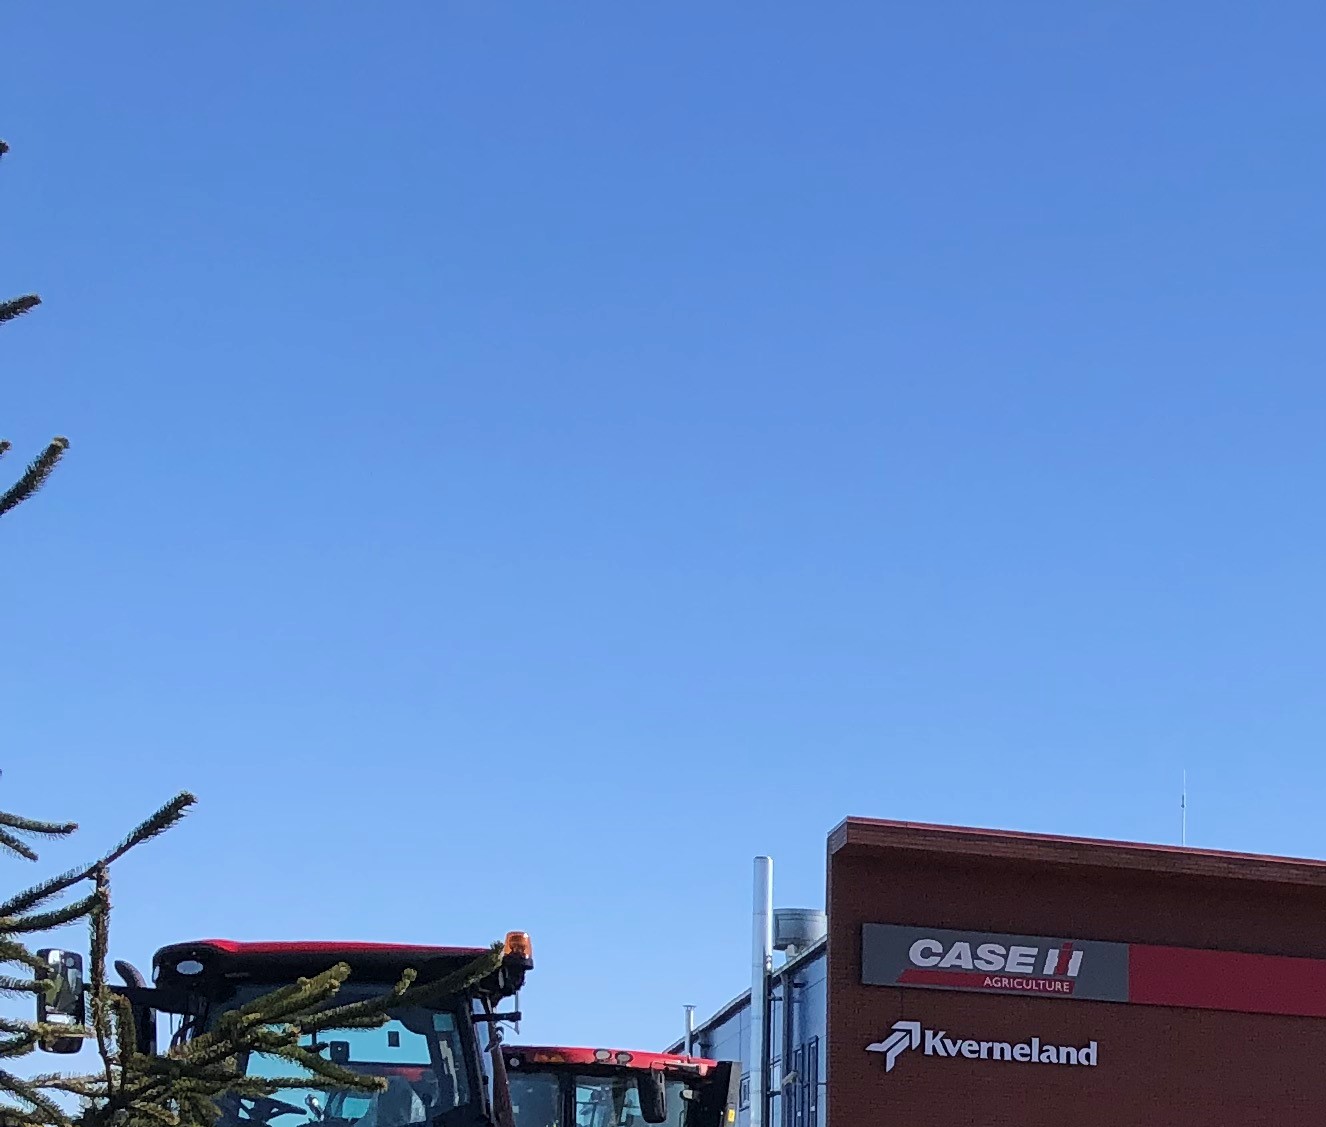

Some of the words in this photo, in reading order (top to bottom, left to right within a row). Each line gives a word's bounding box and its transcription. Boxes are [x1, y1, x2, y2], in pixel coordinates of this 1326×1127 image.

[908, 938, 1039, 974] CASE
[983, 976, 1070, 993] AGRICULTURE
[923, 1029, 1098, 1067] Kverneland
